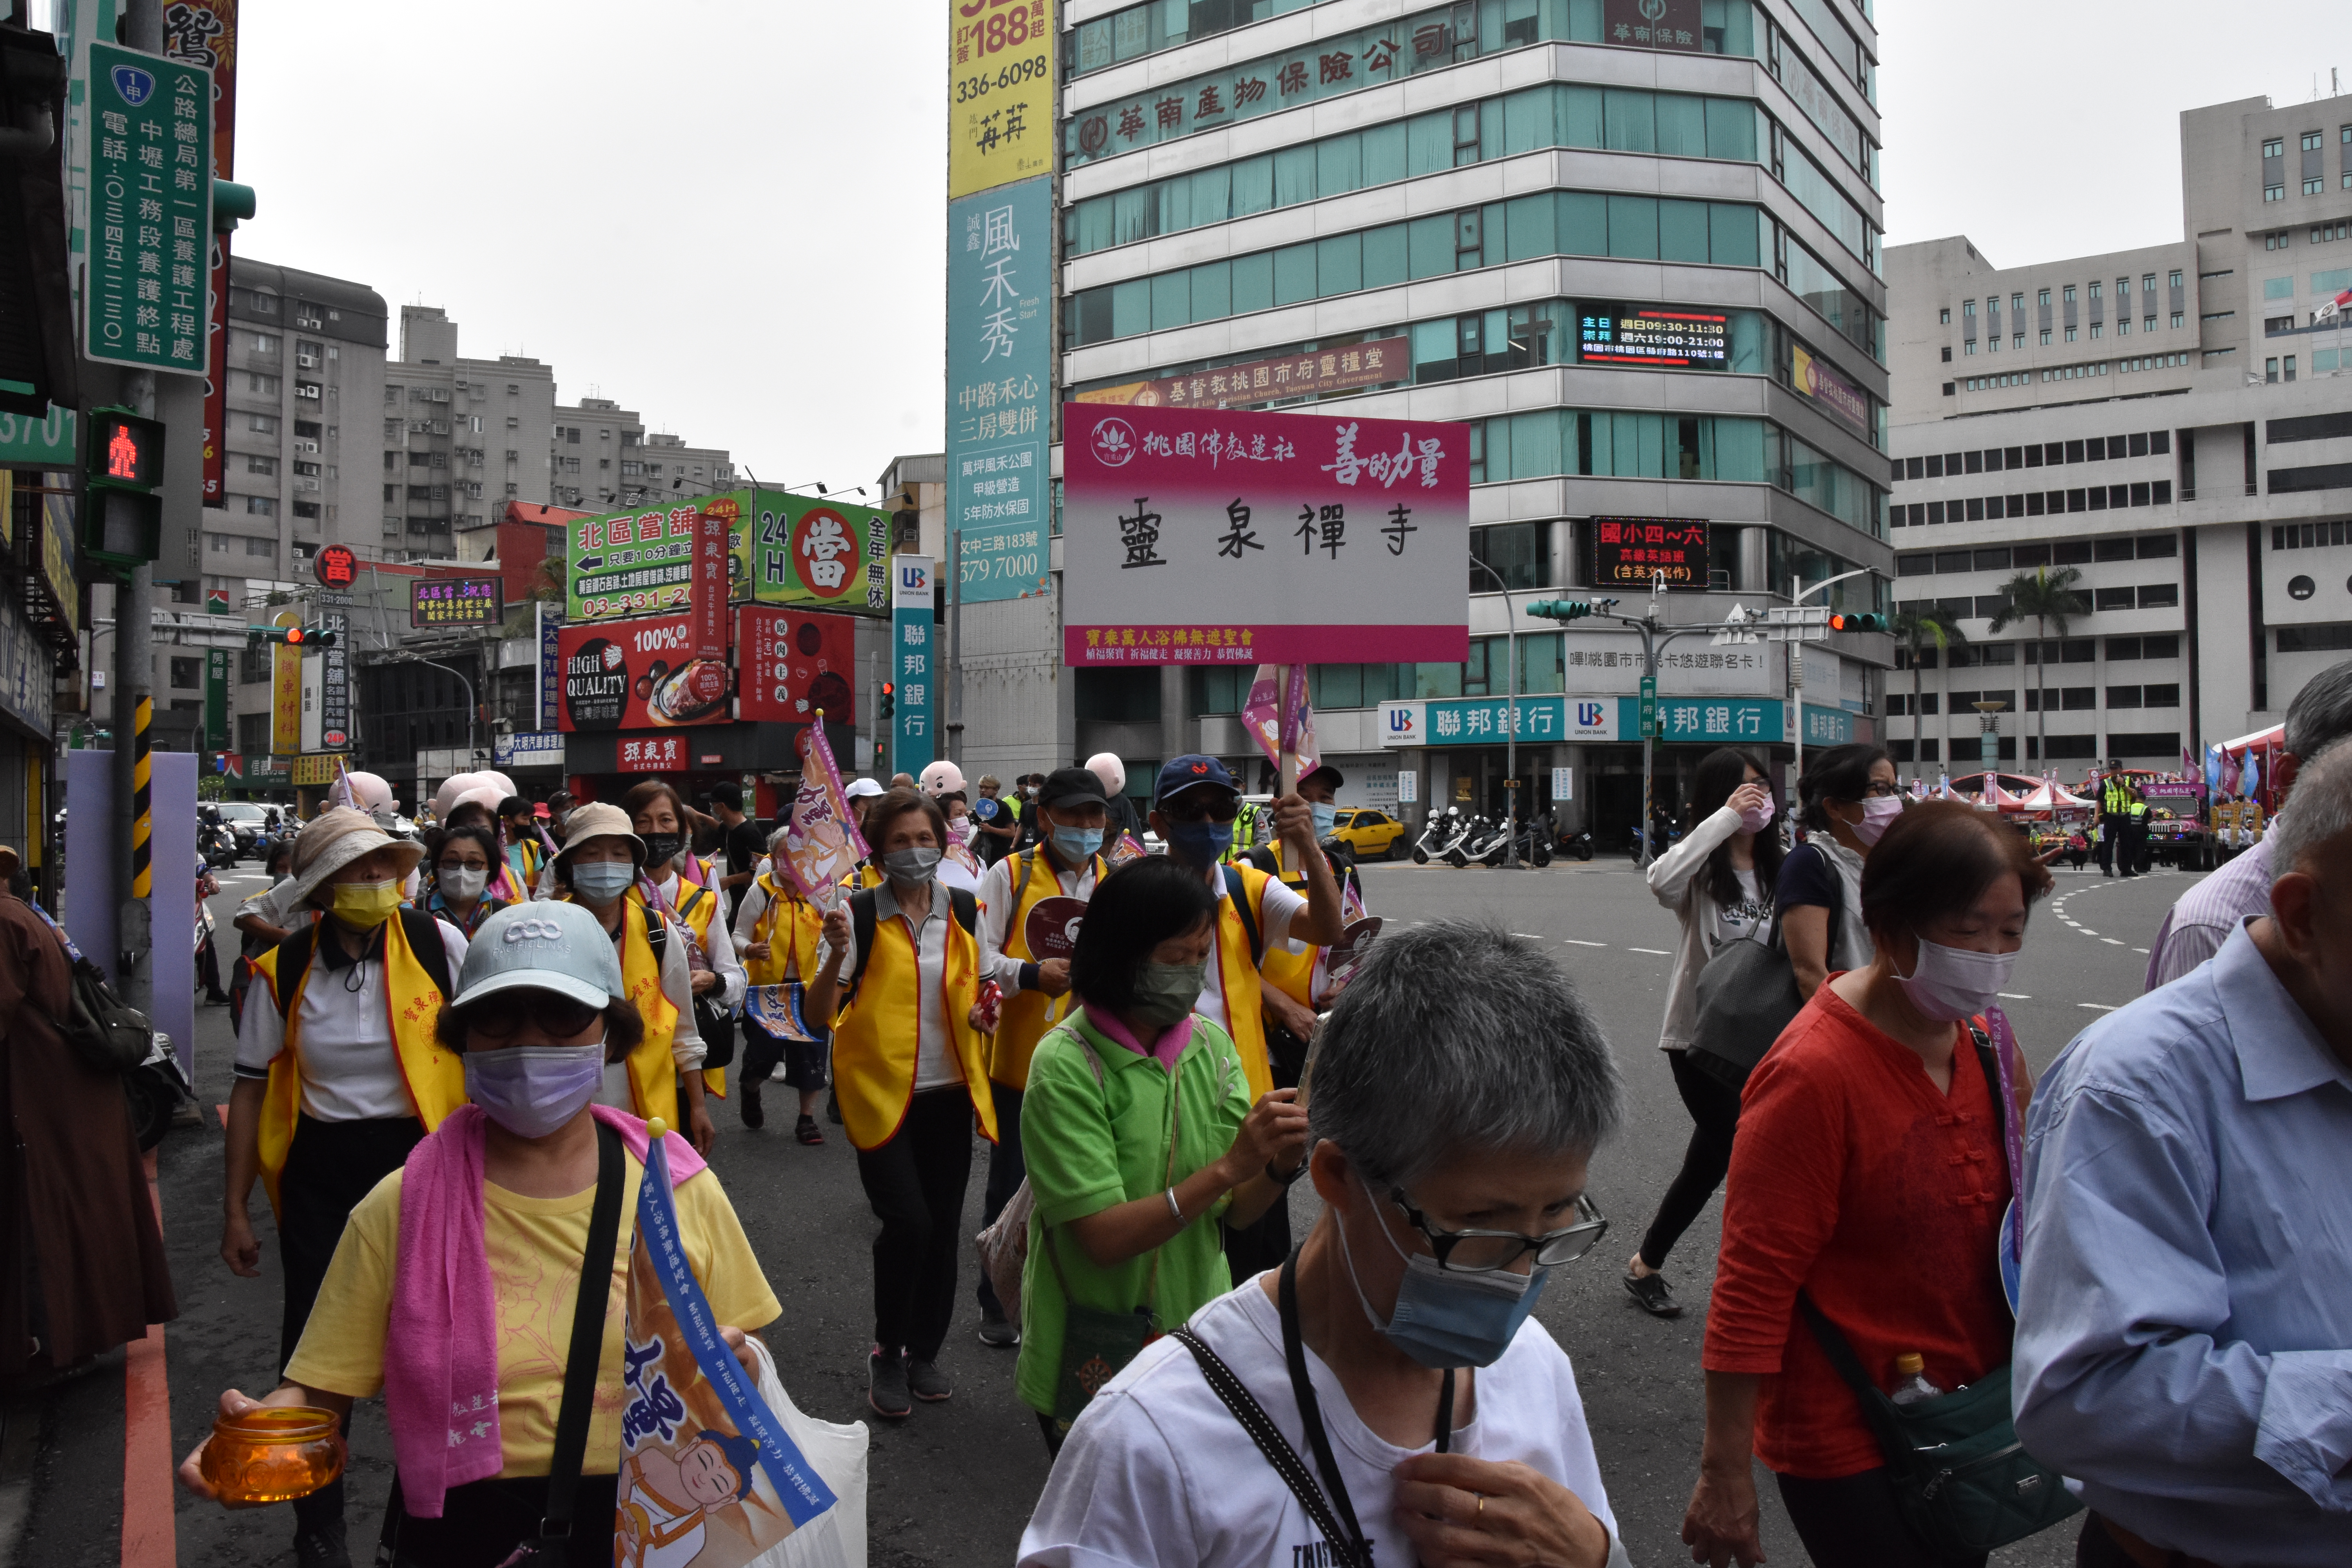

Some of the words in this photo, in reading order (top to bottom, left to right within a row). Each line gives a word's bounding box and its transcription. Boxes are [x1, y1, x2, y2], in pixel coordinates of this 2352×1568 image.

[969, 5, 1028, 58] 188
[1030, 0, 1045, 39] 萬起
[1613, 22, 1694, 45] 華南保險
[957, 25, 970, 65] 訂簽
[956, 55, 1047, 103] 336-6098
[1116, 23, 1445, 142] 華南產物保險公司
[171, 74, 199, 361] 公路總局第一區養護工程處
[136, 120, 163, 355] 中壢工務段養護終點
[966, 214, 980, 252] 誠鑫
[980, 204, 1020, 363] 風禾秀
[1020, 296, 1039, 308] Fresh
[1020, 309, 1037, 319] Start
[1583, 317, 1610, 328] 主日
[1583, 330, 1612, 341] 崇拜
[1169, 347, 1384, 402] 基督教桃園市府靈糧堂
[1202, 399, 1215, 407] Life
[1285, 383, 1315, 394] Taoyuan
[1318, 379, 1333, 388] City
[1336, 371, 1383, 385] Government
[959, 374, 1038, 413] 中路禾心
[959, 405, 1038, 443] 三房雙併
[1143, 428, 1296, 470] 桃園佛教蓮社
[1320, 422, 1446, 489] 善的力量
[962, 451, 1032, 478] 萬坪風禾公園
[973, 477, 1020, 498] 甲級營造
[706, 503, 736, 516] 24H
[964, 499, 1029, 521] 5年防水保固
[960, 531, 1038, 555] 文中三路183號
[1118, 497, 1418, 569] 靈泉禪寺
[324, 550, 352, 582] 當
[801, 516, 851, 589] 當
[867, 516, 887, 608] 全年無休
[1620, 548, 1685, 563] 高級英語班
[960, 560, 990, 583] 379
[996, 553, 1038, 580] 7000
[321, 594, 352, 606] 331-2000
[418, 584, 492, 599] 北區當祝您
[634, 626, 677, 652] 100%
[1086, 628, 1254, 647] 寶乘萬人浴佛無遮聖會
[212, 652, 224, 679] 房屋
[567, 654, 600, 674] HIGH
[777, 622, 786, 700] 原肉主義
[1086, 647, 1124, 660] 植福聚寶
[1131, 648, 1168, 660] 祈福健走
[1174, 648, 1211, 660] 凝聚善力
[1217, 647, 1253, 660] 恭賀佛誕
[567, 674, 626, 697] QUALITY
[701, 673, 718, 682] 100%
[904, 624, 925, 736] 聯邦銀行
[1436, 706, 1553, 736] 聯邦銀行
[1642, 689, 1653, 731] 縣府路
[327, 732, 345, 743] 24H
[251, 759, 287, 776] 信義
[633, 762, 671, 770] 台式牛排教父
[404, 991, 445, 1022] 靈泉禪
[1293, 1540, 1329, 1568] THIS
